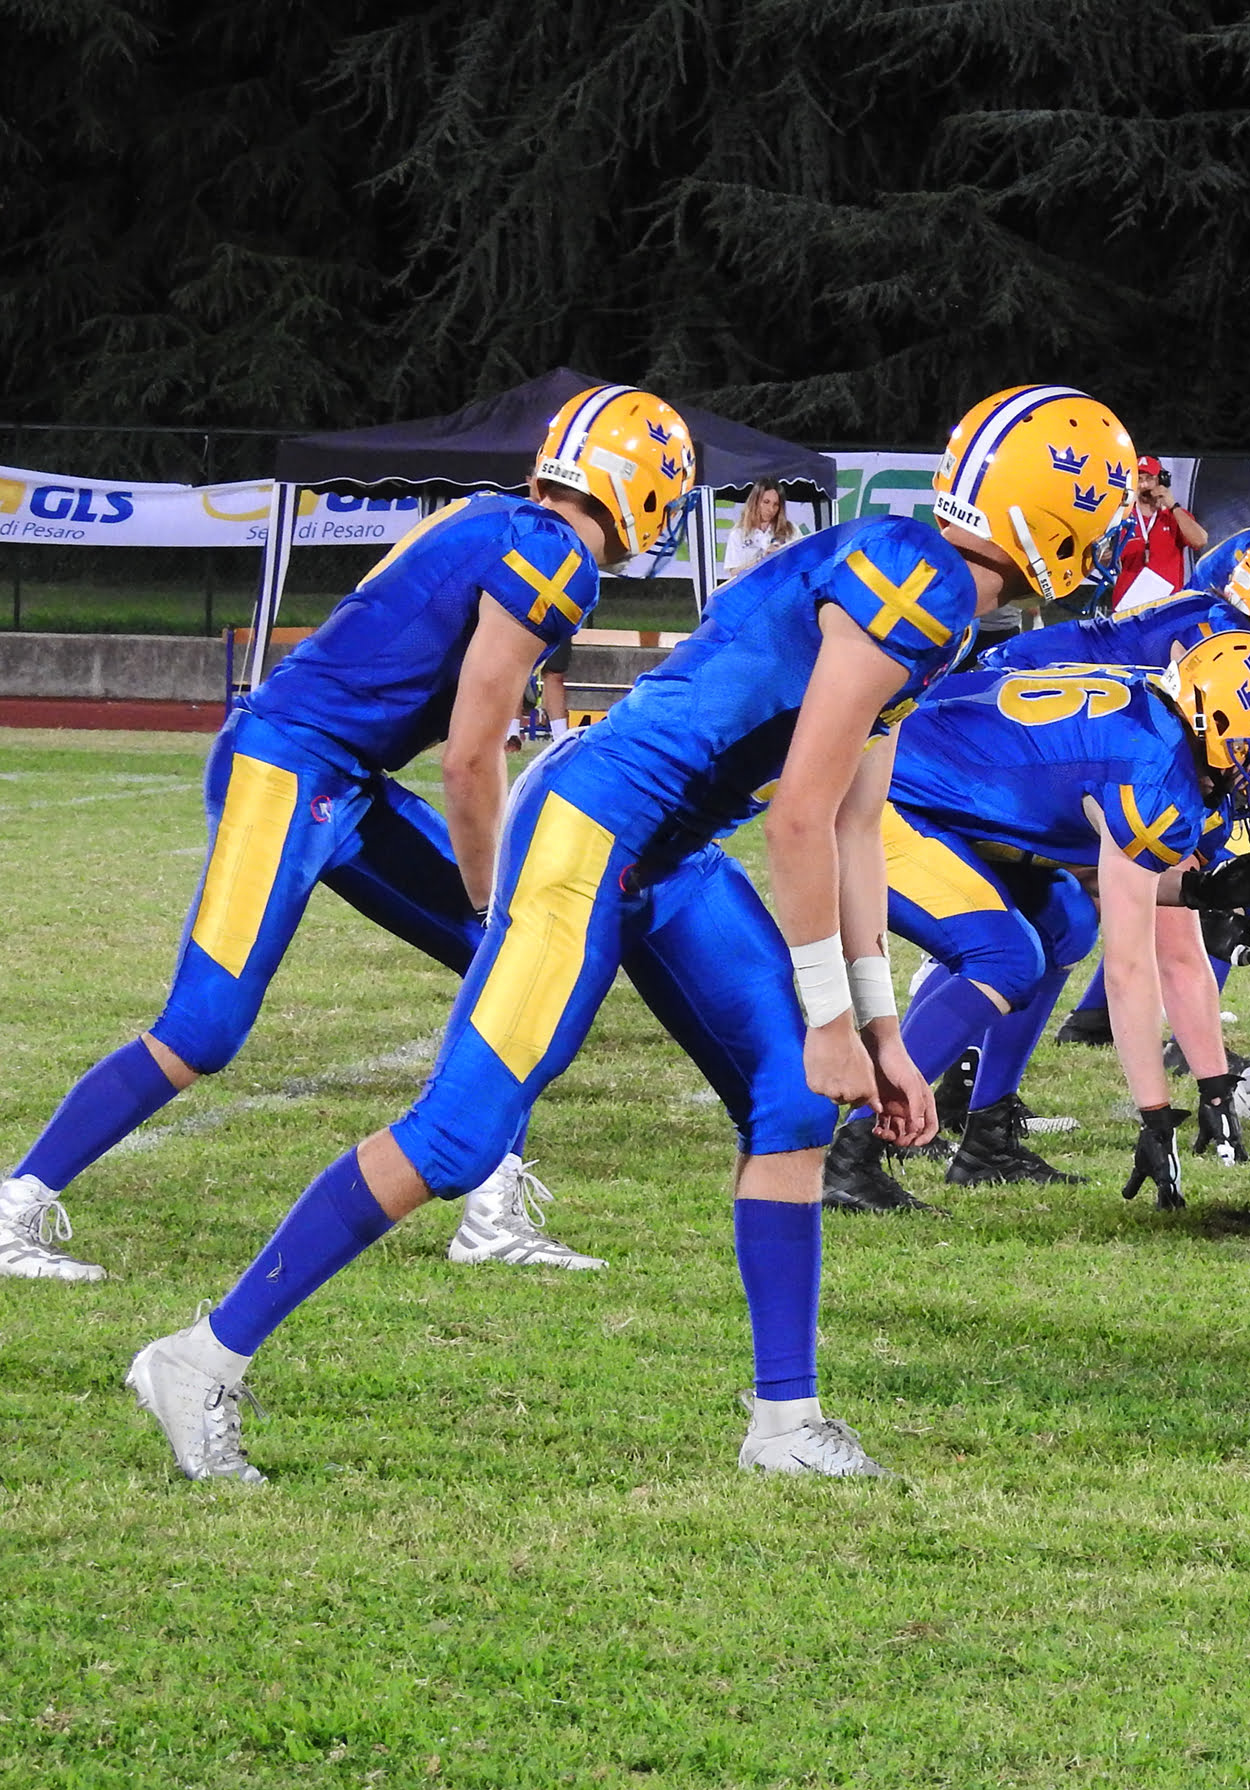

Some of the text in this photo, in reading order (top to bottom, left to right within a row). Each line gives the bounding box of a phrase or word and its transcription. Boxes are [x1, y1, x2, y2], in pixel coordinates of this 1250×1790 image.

[541, 463, 582, 482] schutt
[30, 485, 134, 523] GLS
[938, 496, 982, 527] schutt
[0, 520, 86, 540] di Pesaro
[246, 521, 385, 540] Se di Pesaro
